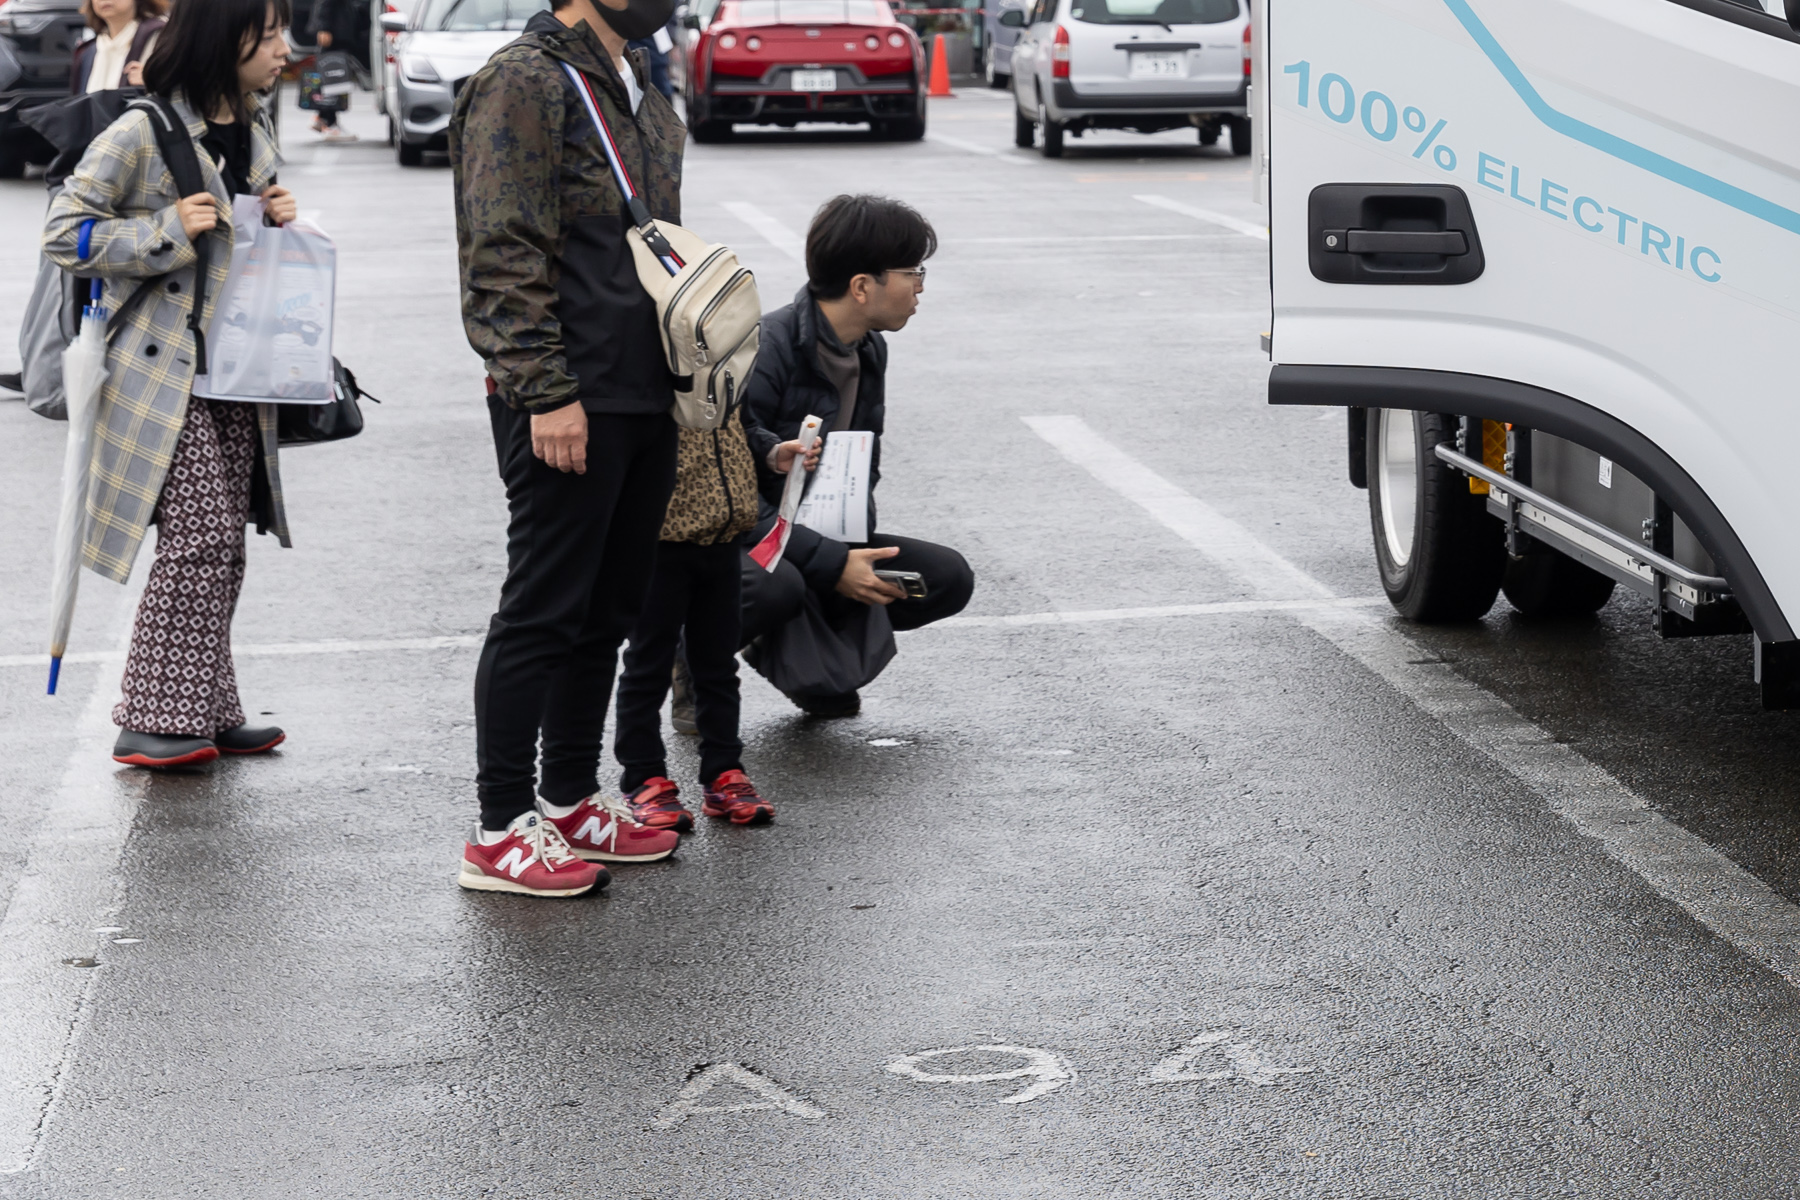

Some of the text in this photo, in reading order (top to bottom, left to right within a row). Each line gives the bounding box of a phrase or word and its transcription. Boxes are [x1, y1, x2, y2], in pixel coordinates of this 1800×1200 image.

[1283, 58, 1723, 284] 100% ELECTRIC
[572, 815, 614, 846] N
[494, 846, 538, 879] N
